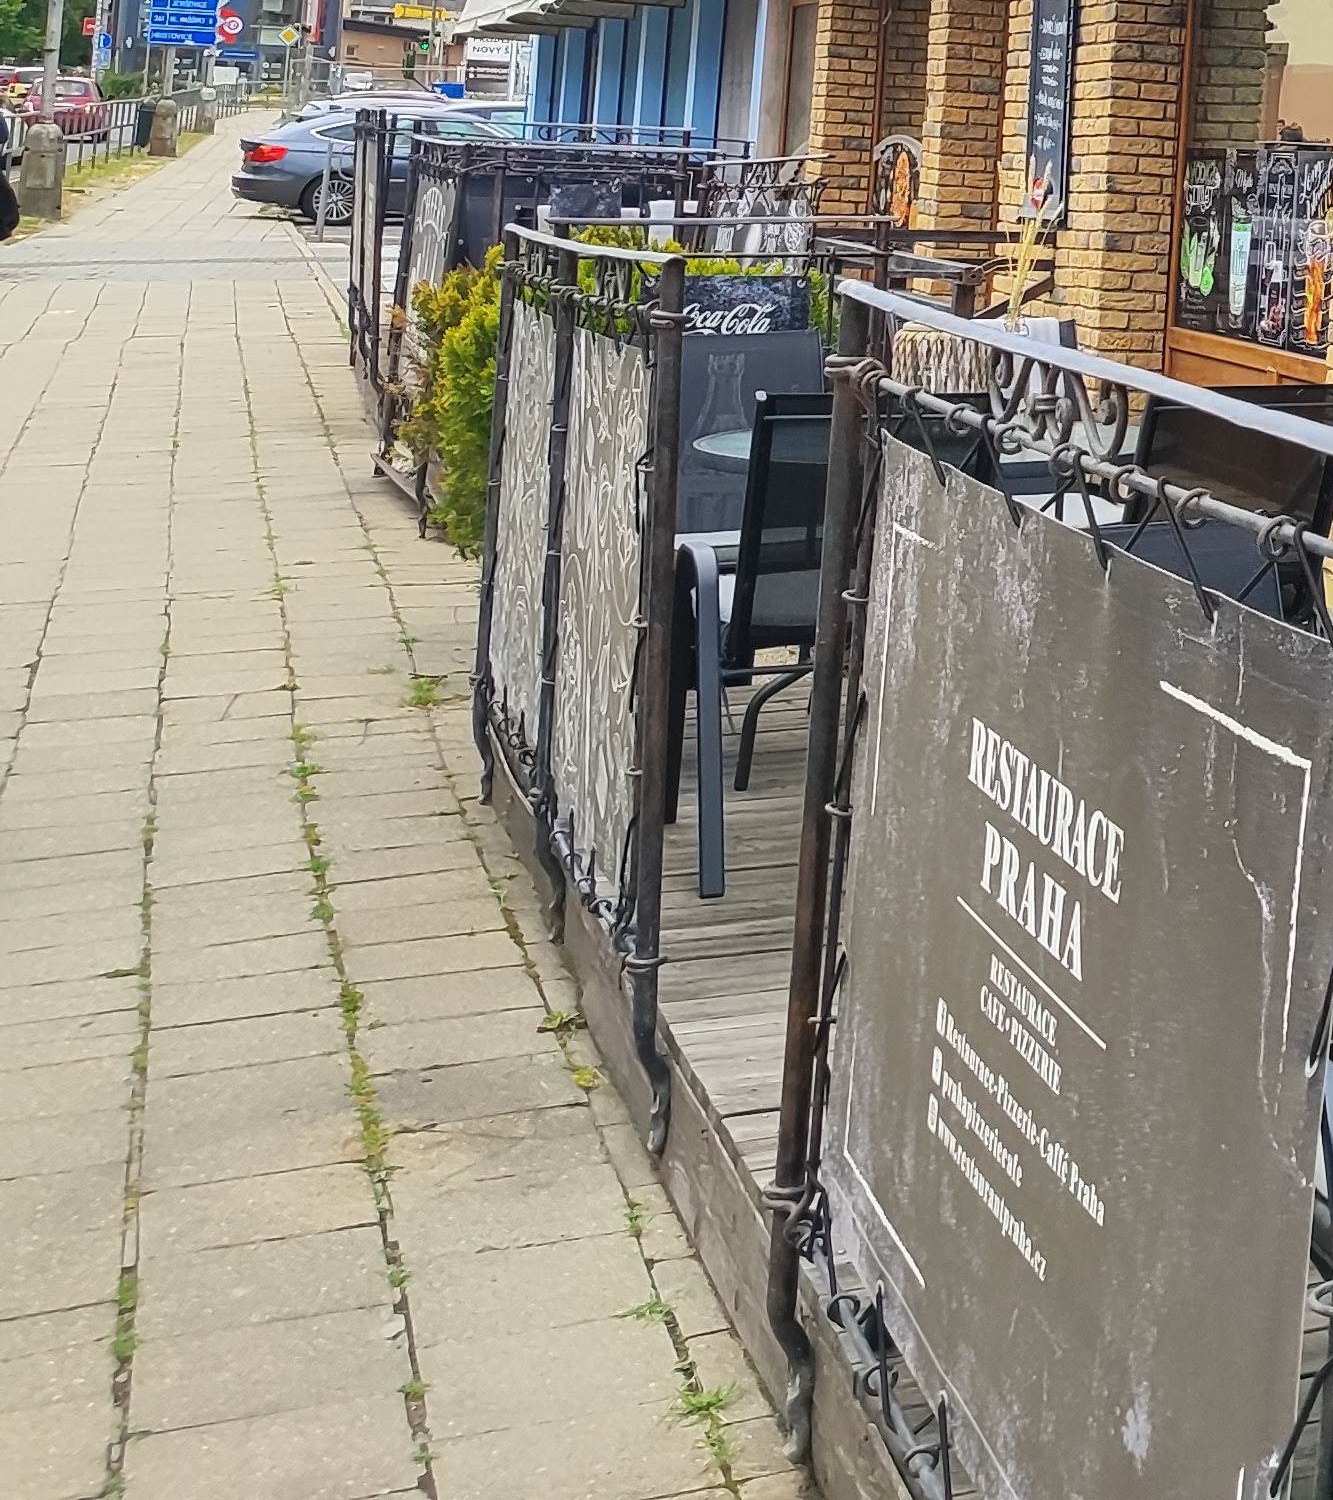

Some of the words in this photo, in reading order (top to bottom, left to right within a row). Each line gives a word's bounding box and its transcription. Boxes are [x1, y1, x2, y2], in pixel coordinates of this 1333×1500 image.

[967, 716, 1125, 904] RESTAURACE
[980, 820, 1083, 982] PRAHA
[979, 983, 1006, 1033] CAFE
[1009, 1016, 1062, 1096] PIZZERIE
[988, 953, 1058, 1047] RESTAURACE
[942, 1069, 1024, 1188] prahapizzeriecafe
[938, 1116, 1048, 1283] www.restaurantpraha.cz
[1069, 1161, 1105, 1227] Praha
